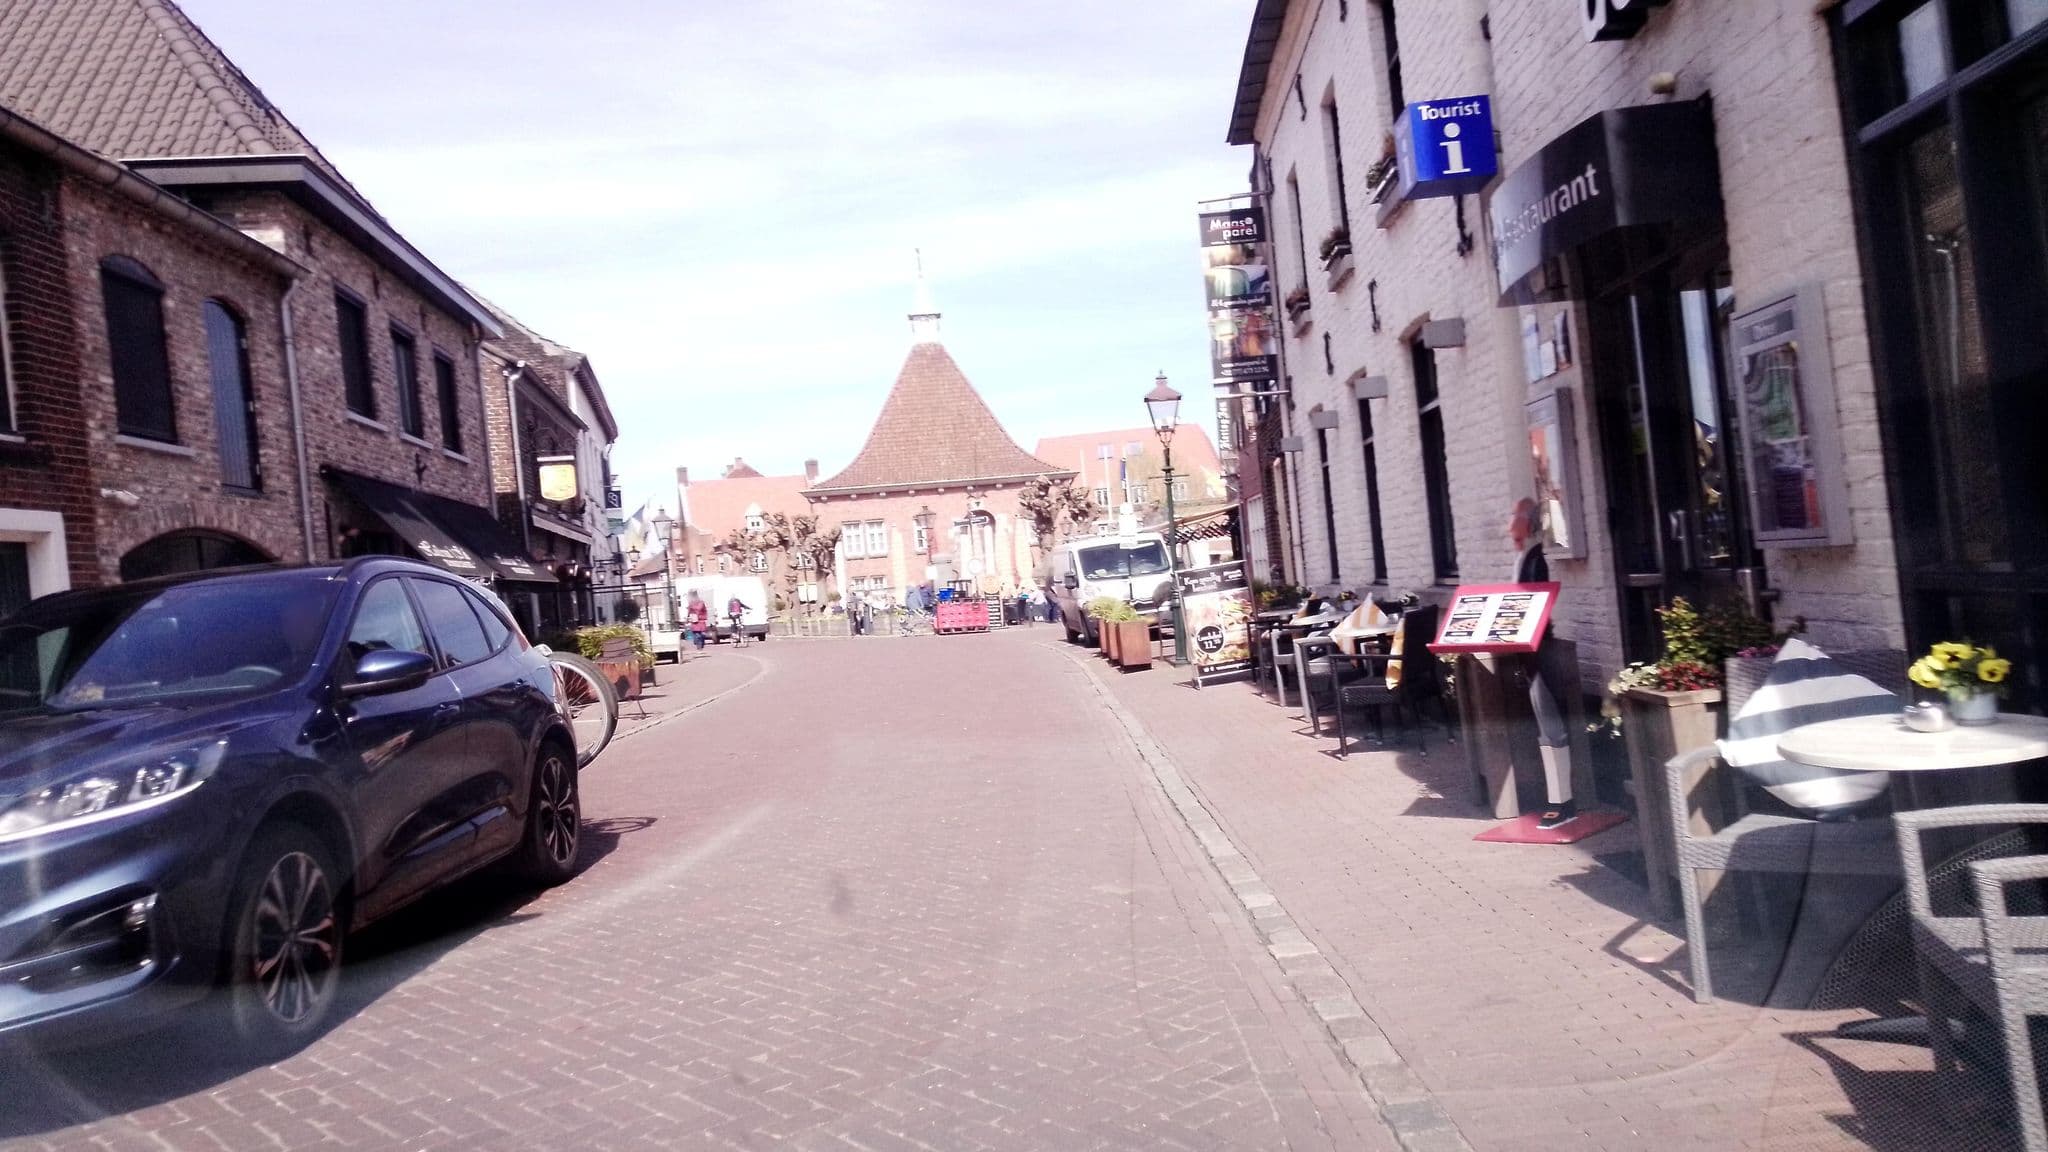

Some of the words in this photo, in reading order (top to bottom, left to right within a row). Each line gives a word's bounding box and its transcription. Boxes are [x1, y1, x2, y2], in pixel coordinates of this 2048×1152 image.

[1417, 101, 1482, 121] Tourist
[1439, 122, 1472, 175] i
[1222, 224, 1258, 241] parel
